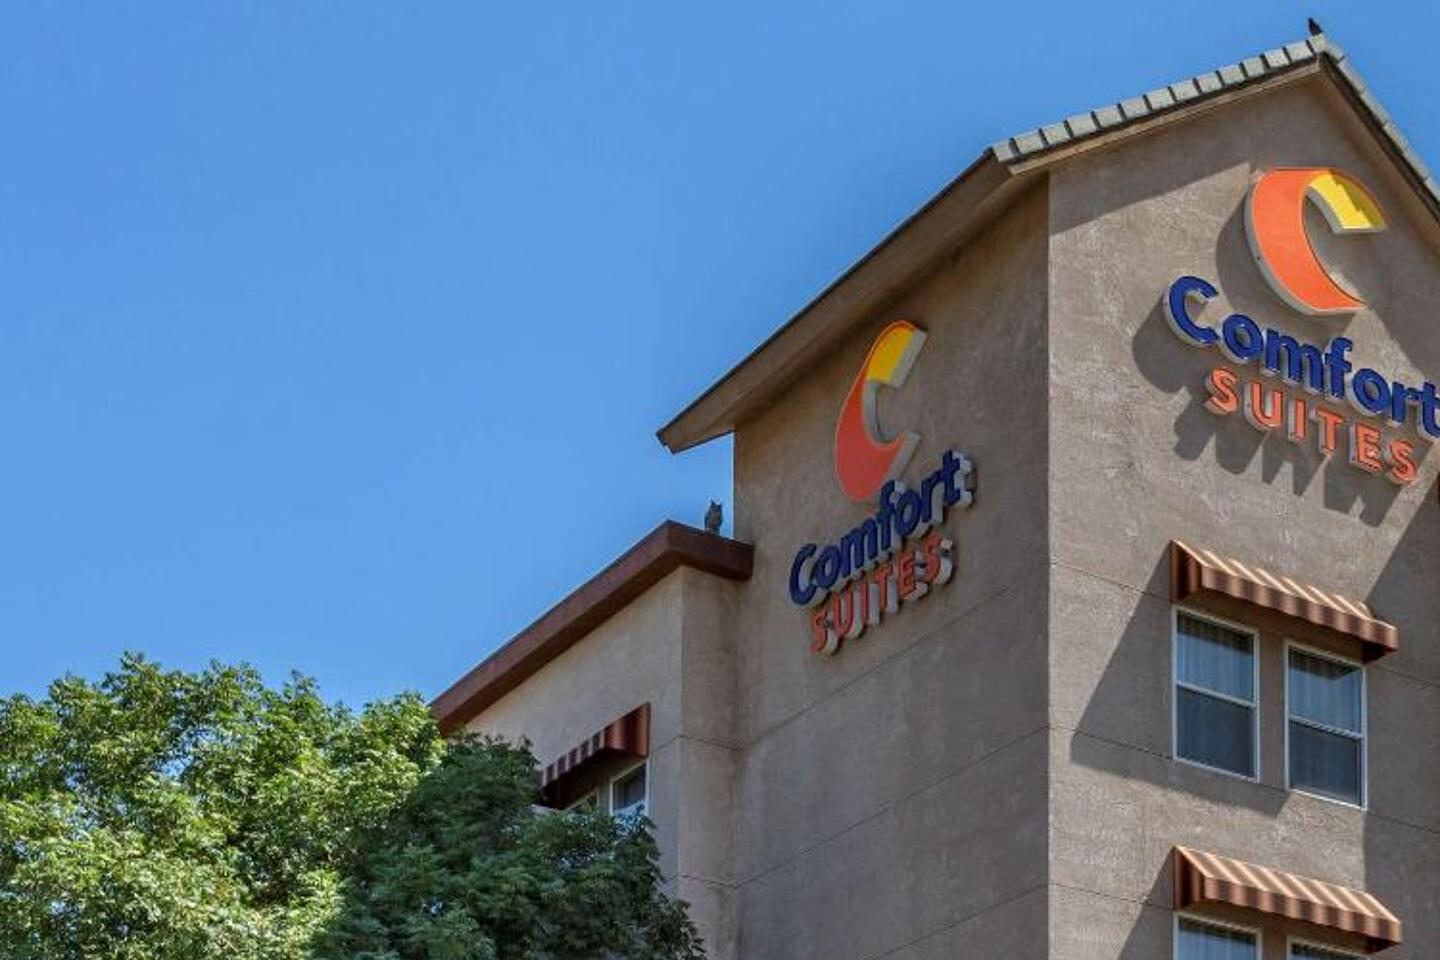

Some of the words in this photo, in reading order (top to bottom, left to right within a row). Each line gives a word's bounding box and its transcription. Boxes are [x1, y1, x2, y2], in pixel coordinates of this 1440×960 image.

[1205, 366, 1418, 485] SUITES
[789, 449, 975, 607] Comfort
[810, 531, 953, 654] SUITES
